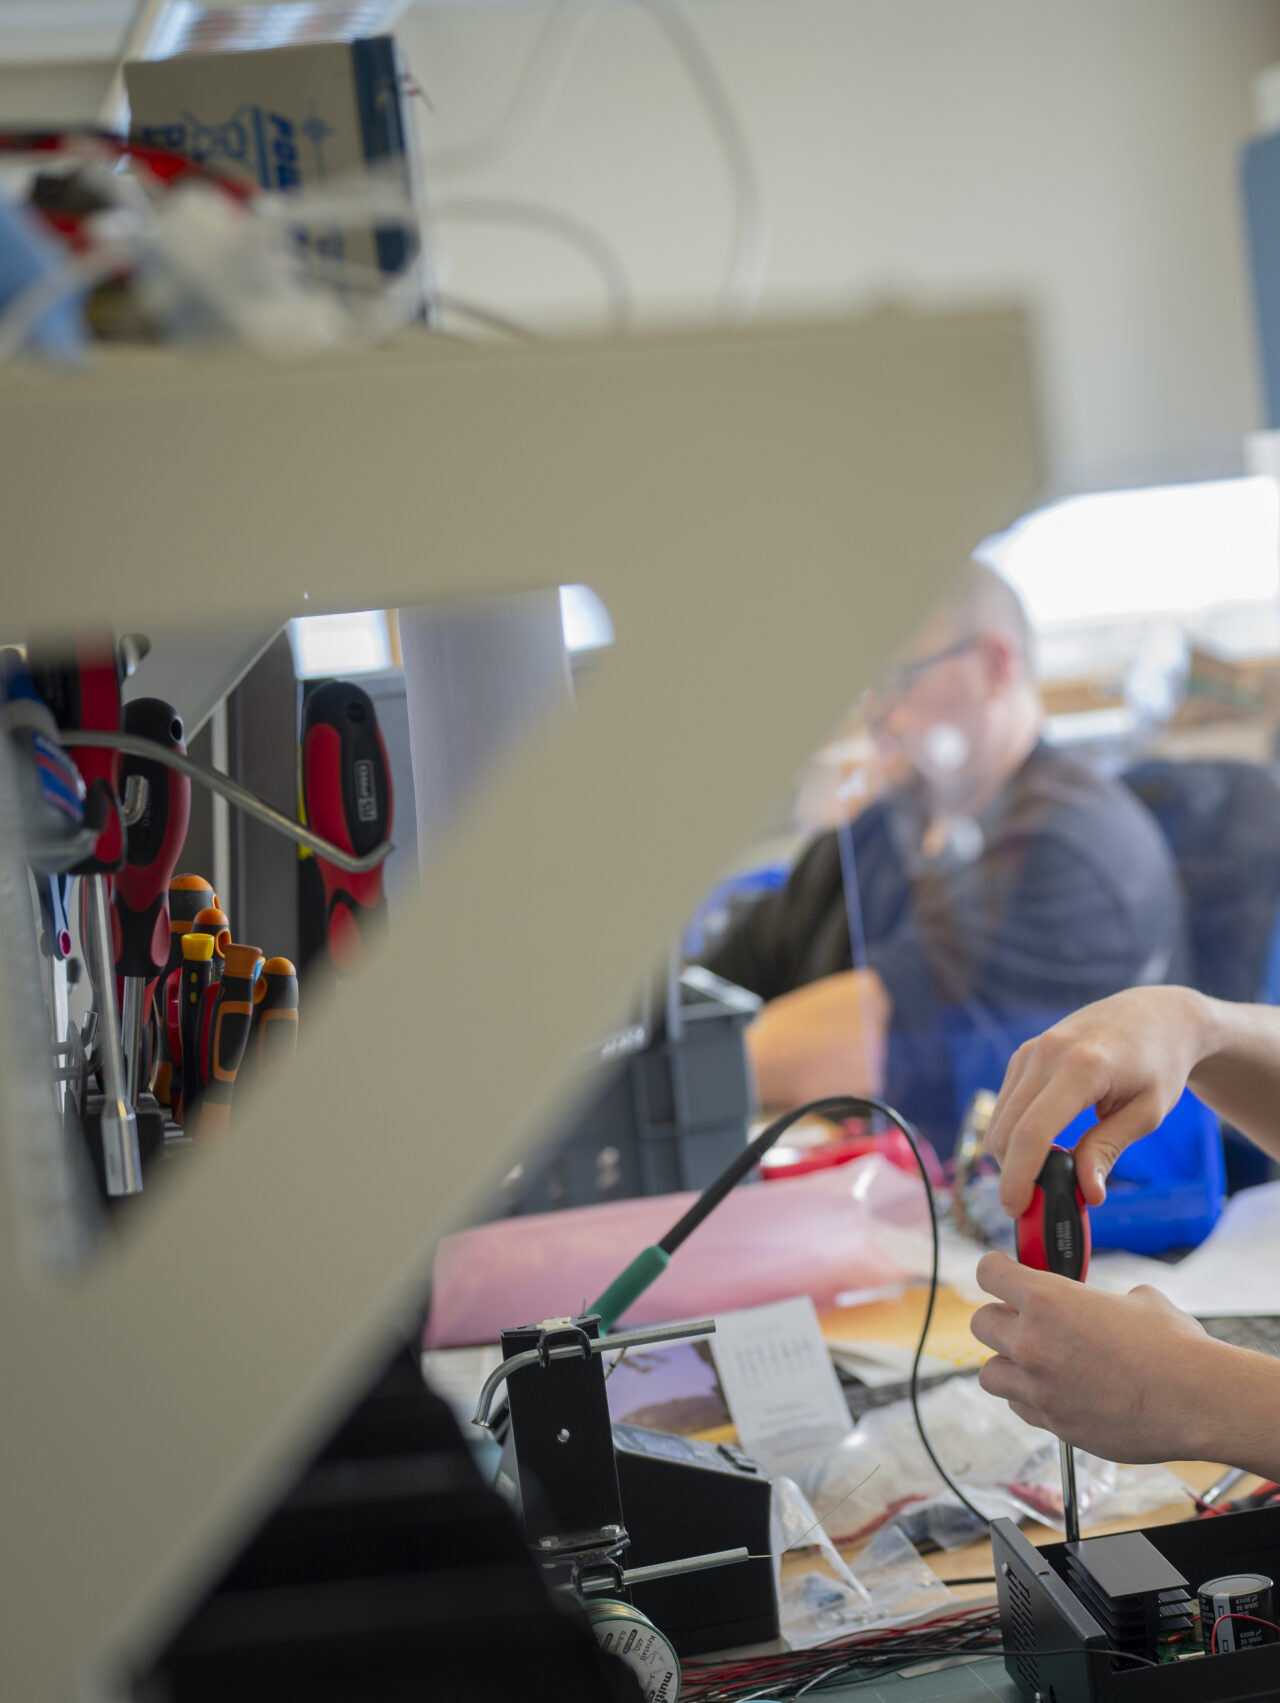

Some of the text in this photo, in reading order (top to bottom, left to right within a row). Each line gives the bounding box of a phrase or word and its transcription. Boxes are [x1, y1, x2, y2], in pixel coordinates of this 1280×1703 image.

[359, 764, 369, 797] PRO
[635, 1638, 644, 1651] 400
[640, 1635, 656, 1661] Kristall
[653, 1671, 673, 1703] multi
